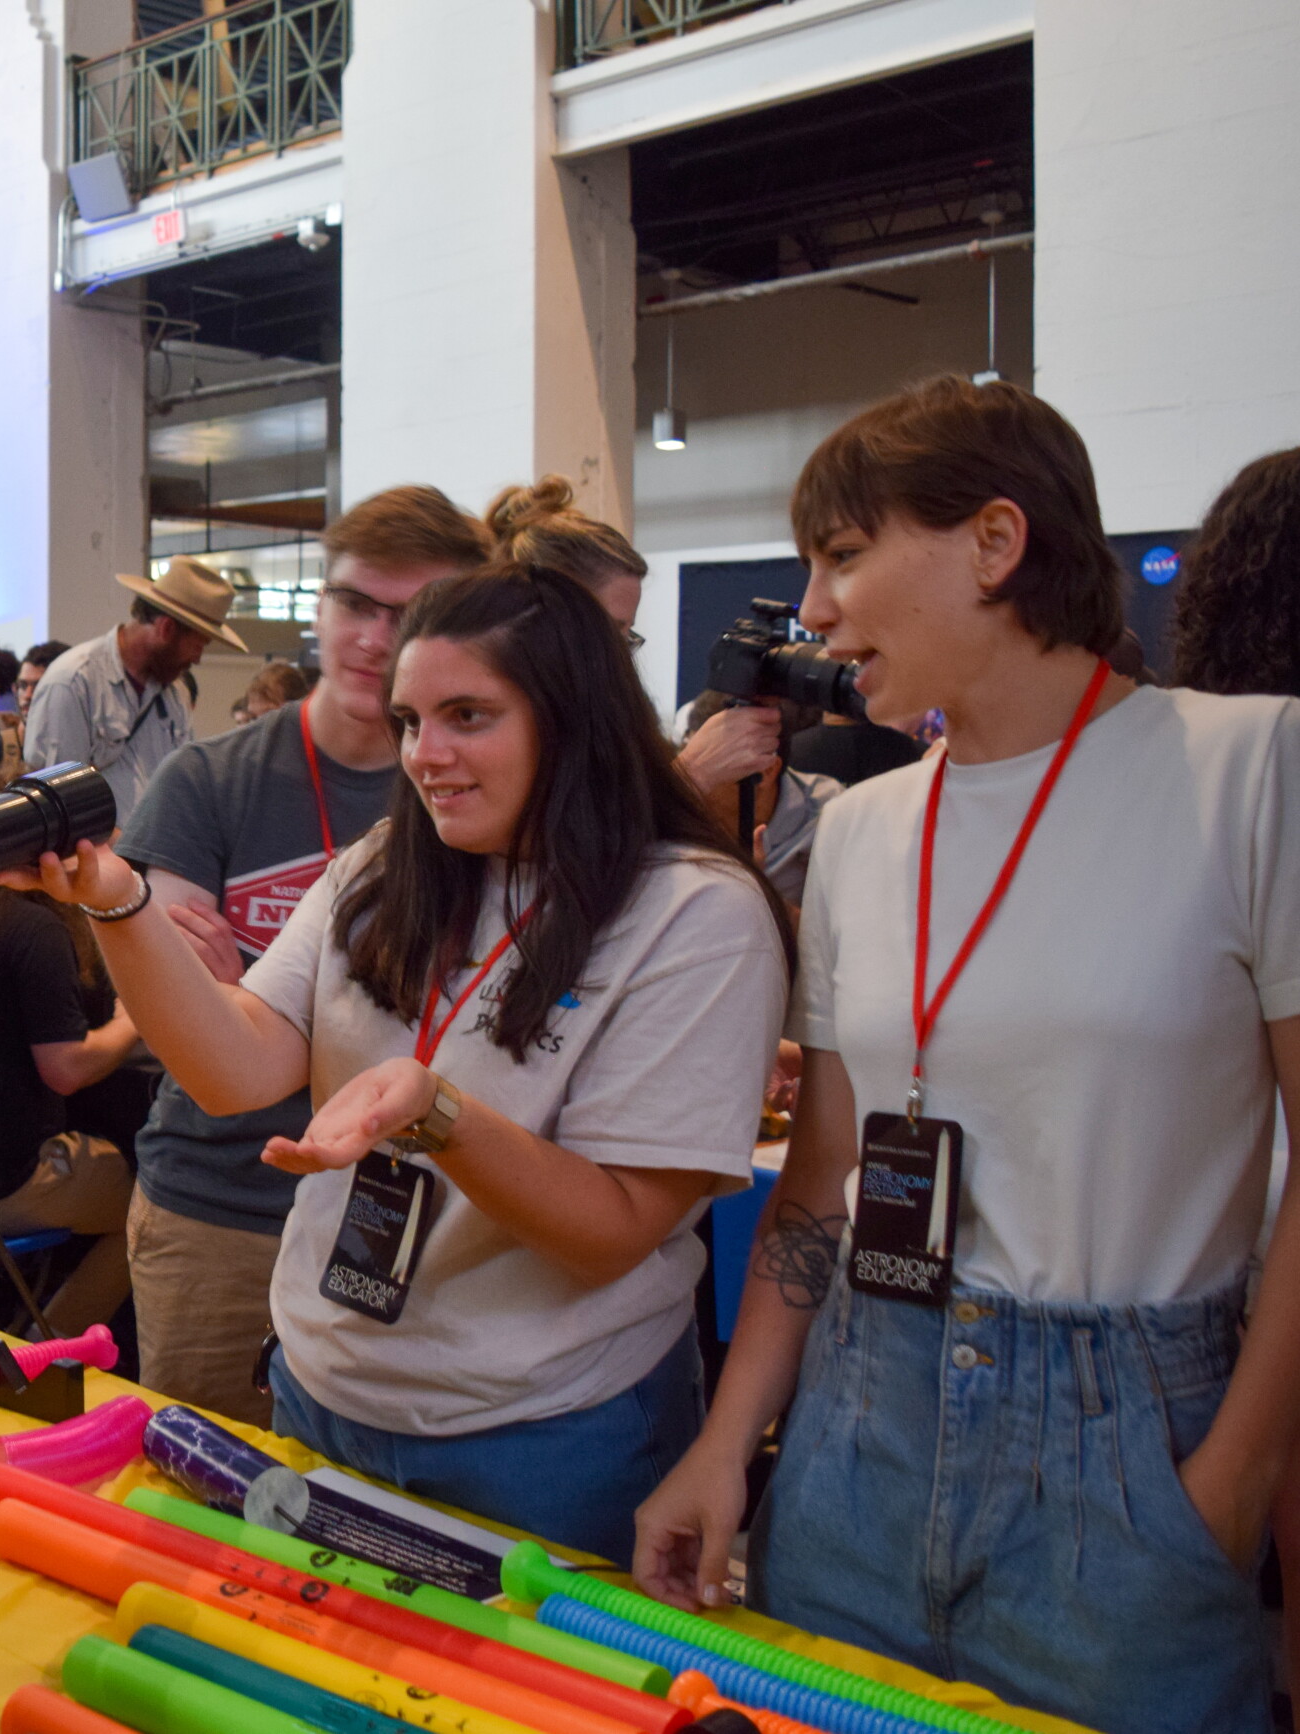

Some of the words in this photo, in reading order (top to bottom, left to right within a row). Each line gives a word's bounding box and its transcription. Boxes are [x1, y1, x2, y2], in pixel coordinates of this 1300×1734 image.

[155, 210, 182, 245] EXIT
[1144, 561, 1176, 572] NASA
[863, 1180, 908, 1199] FESTIVAL
[864, 1169, 933, 1191] ASTRONOMY
[350, 1206, 385, 1229] FESTIVAL
[351, 1196, 406, 1224] ASTRONOMY
[853, 1249, 943, 1281] ASTRONOMY
[856, 1264, 934, 1296] EDUCATOR
[327, 1275, 389, 1313] EDUCATOR
[329, 1263, 400, 1300] ASTRONOMY
